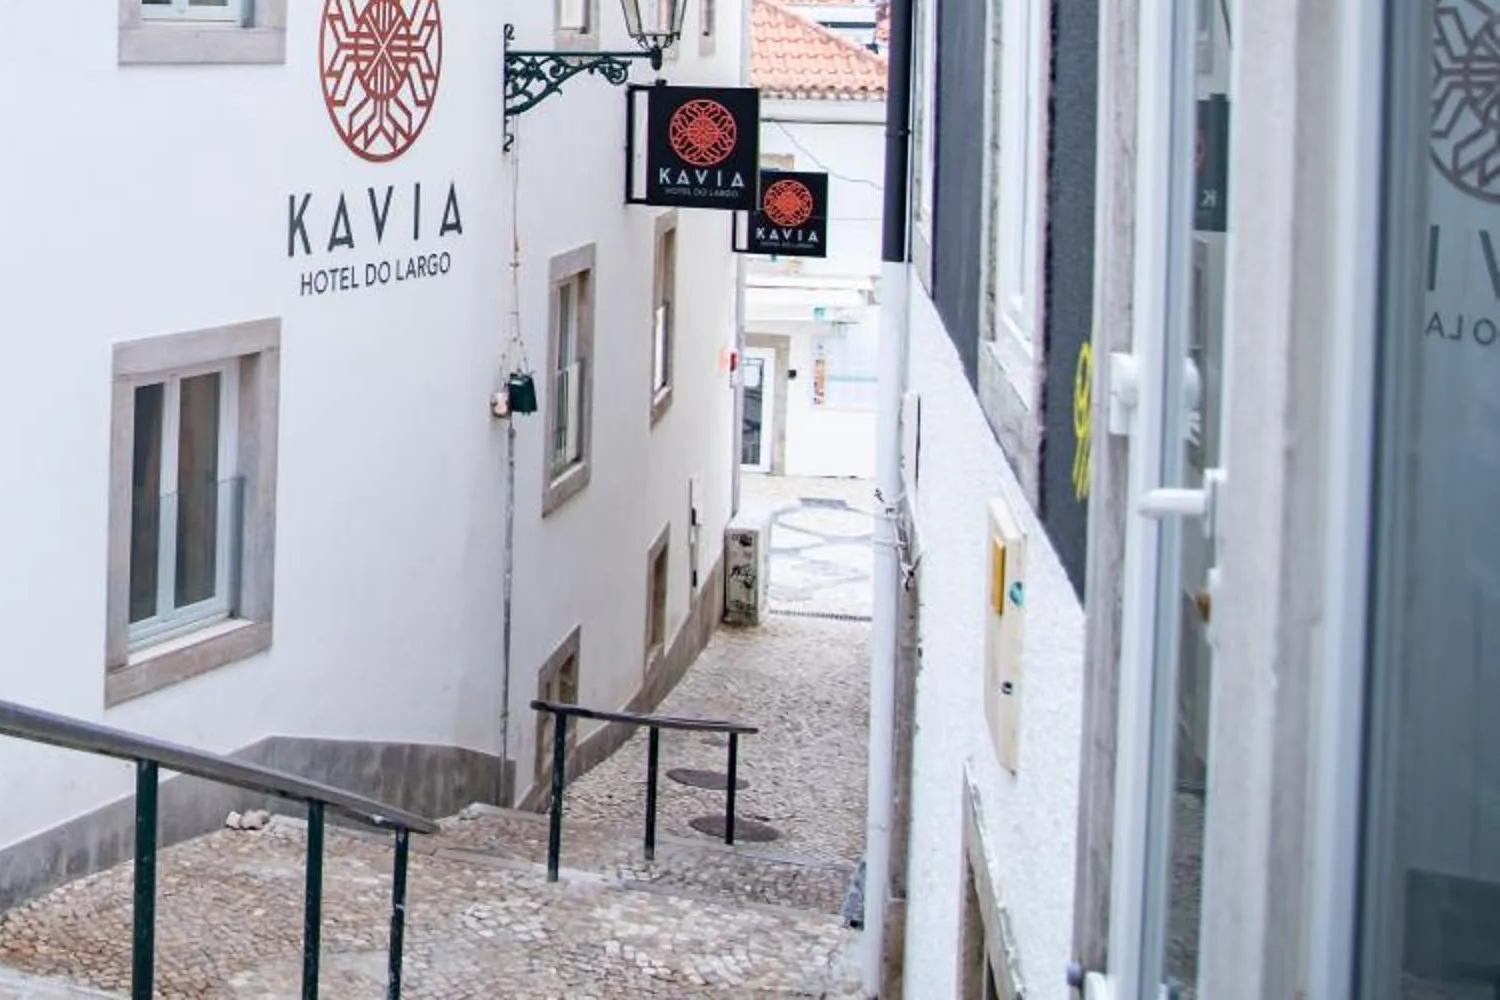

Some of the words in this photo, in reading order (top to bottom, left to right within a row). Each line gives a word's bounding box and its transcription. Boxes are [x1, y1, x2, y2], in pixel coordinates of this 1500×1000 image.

[658, 167, 745, 187] KAVIA
[288, 181, 463, 258] KAVIA
[755, 227, 819, 243] KAVIA
[300, 265, 359, 296] HOTEL
[365, 261, 391, 287] DO
[395, 251, 451, 281] LARGO
